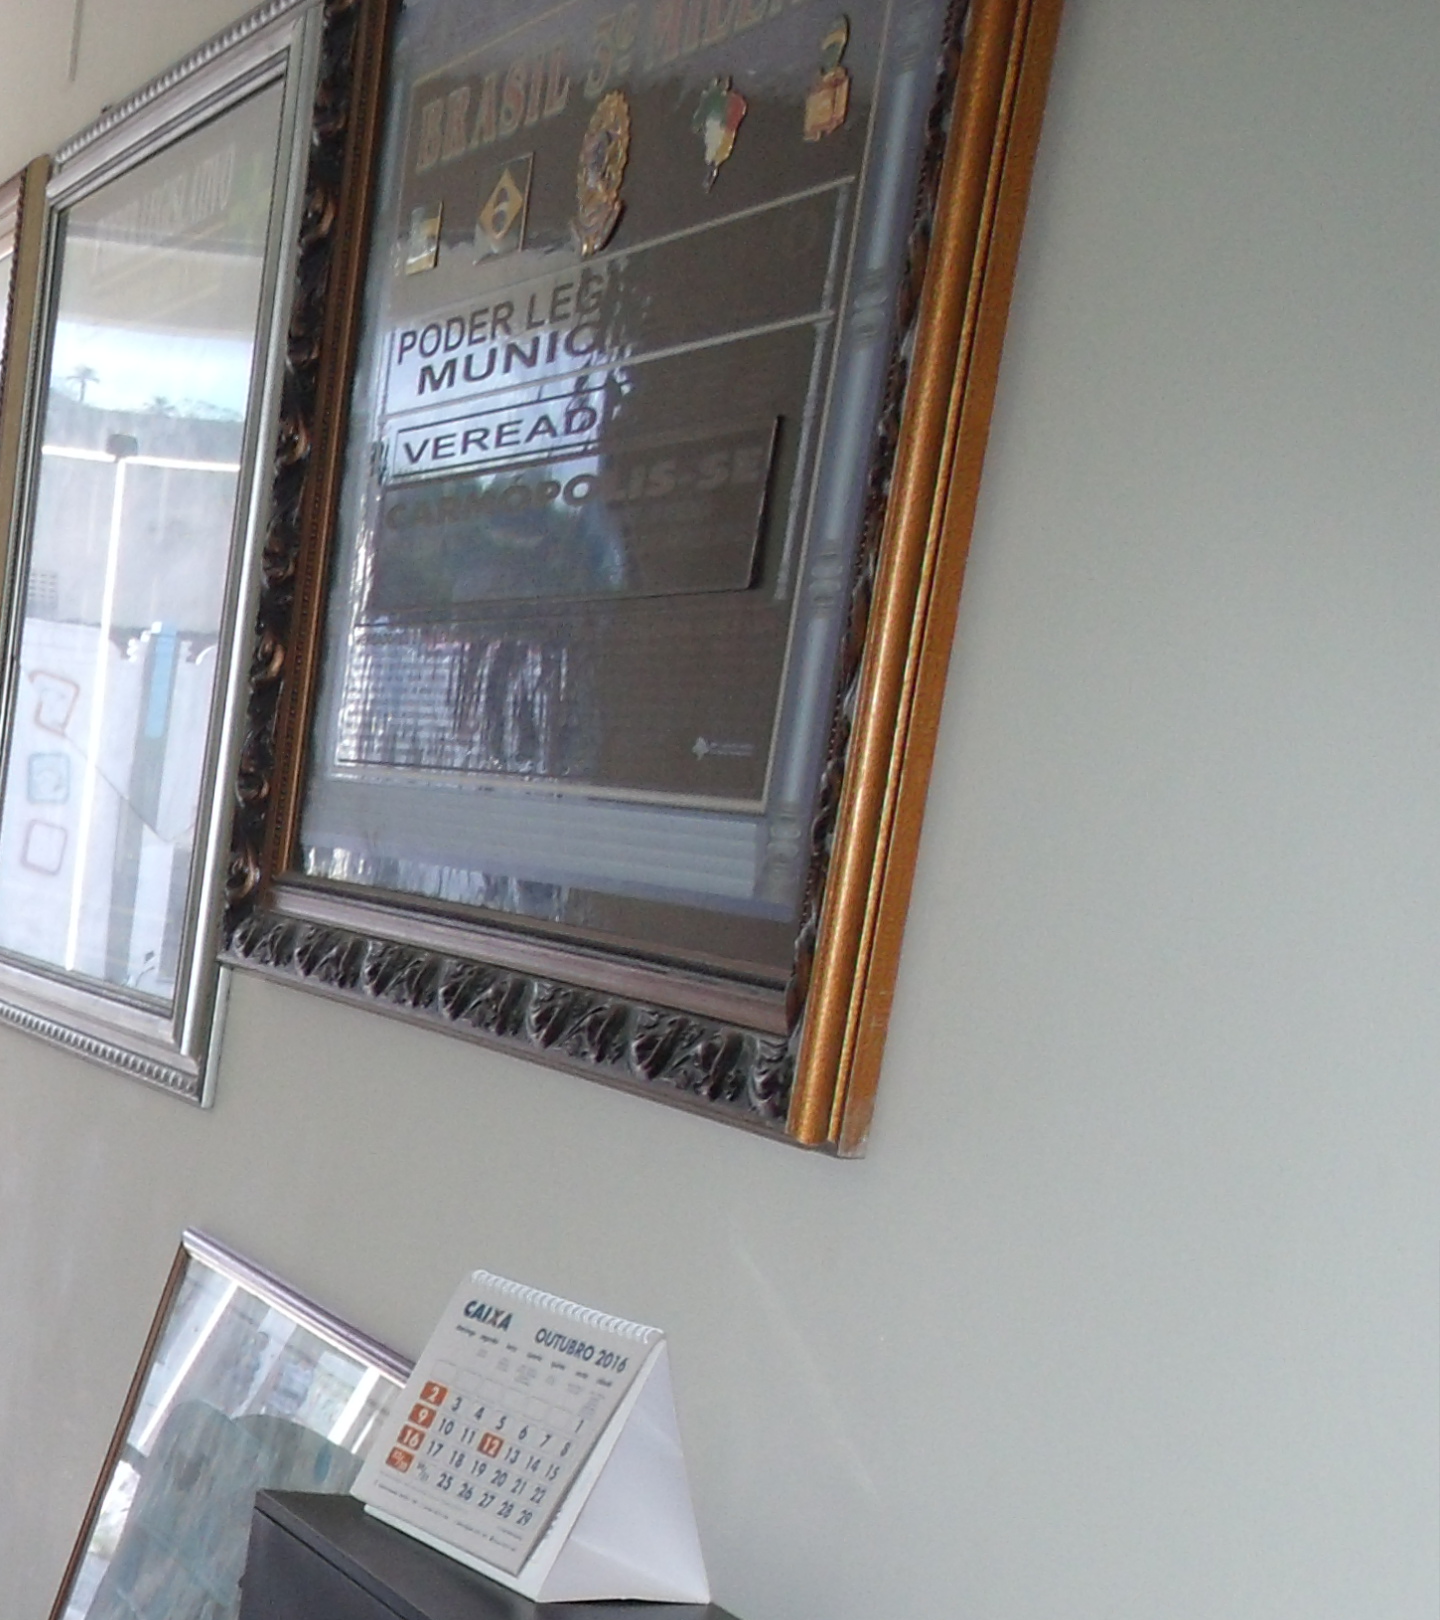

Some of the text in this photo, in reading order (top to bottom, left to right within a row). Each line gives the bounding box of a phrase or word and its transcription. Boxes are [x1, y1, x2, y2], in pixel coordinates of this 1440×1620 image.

[397, 268, 605, 364] PODER LEG
[417, 322, 603, 395] MUNIC
[403, 407, 598, 465] VEREAD
[463, 1300, 629, 1374] CAIXA OUTUBRO 2016
[438, 1418, 455, 1436] 10
[461, 1427, 476, 1445] 11
[482, 1436, 501, 1456] 12
[504, 1447, 520, 1464] 13
[525, 1455, 541, 1473] 14
[545, 1463, 560, 1481] 15
[451, 1396, 463, 1412] 3
[474, 1406, 485, 1421] 4
[495, 1415, 507, 1431] 5
[518, 1425, 529, 1440] 6
[539, 1433, 552, 1448] 7
[560, 1441, 572, 1457] 8
[403, 1428, 547, 1504] 16 17 18 19 20 21 22
[436, 1472, 454, 1491] 25
[456, 1482, 474, 1501] 26
[478, 1491, 496, 1508] 27
[496, 1500, 515, 1518] 28
[516, 1509, 533, 1526] 29
